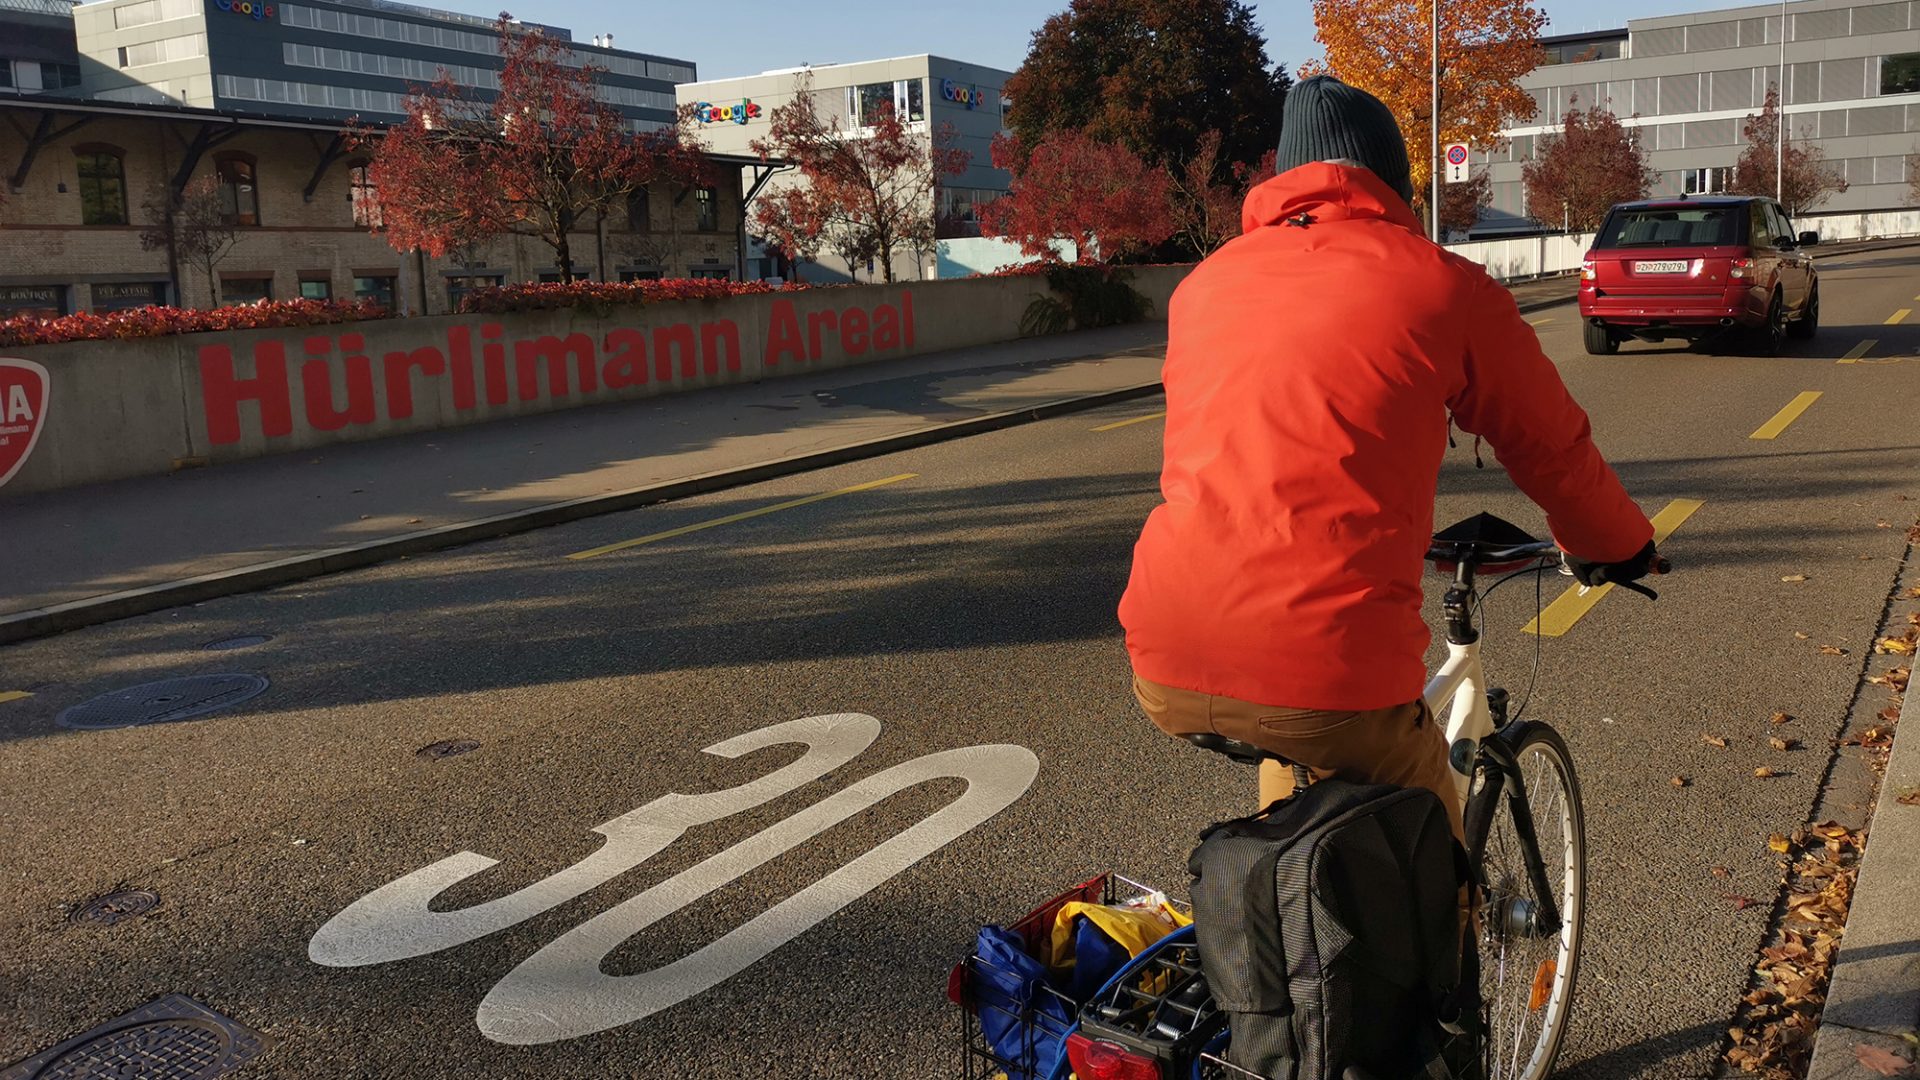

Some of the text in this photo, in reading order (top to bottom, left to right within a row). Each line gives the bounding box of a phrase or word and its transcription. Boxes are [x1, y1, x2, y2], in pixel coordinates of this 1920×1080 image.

[215, 0, 273, 20] Google
[694, 97, 758, 125] Google
[943, 78, 984, 111] Google
[199, 290, 915, 445] Hürlimann Areal
[308, 713, 1040, 1045] 30
